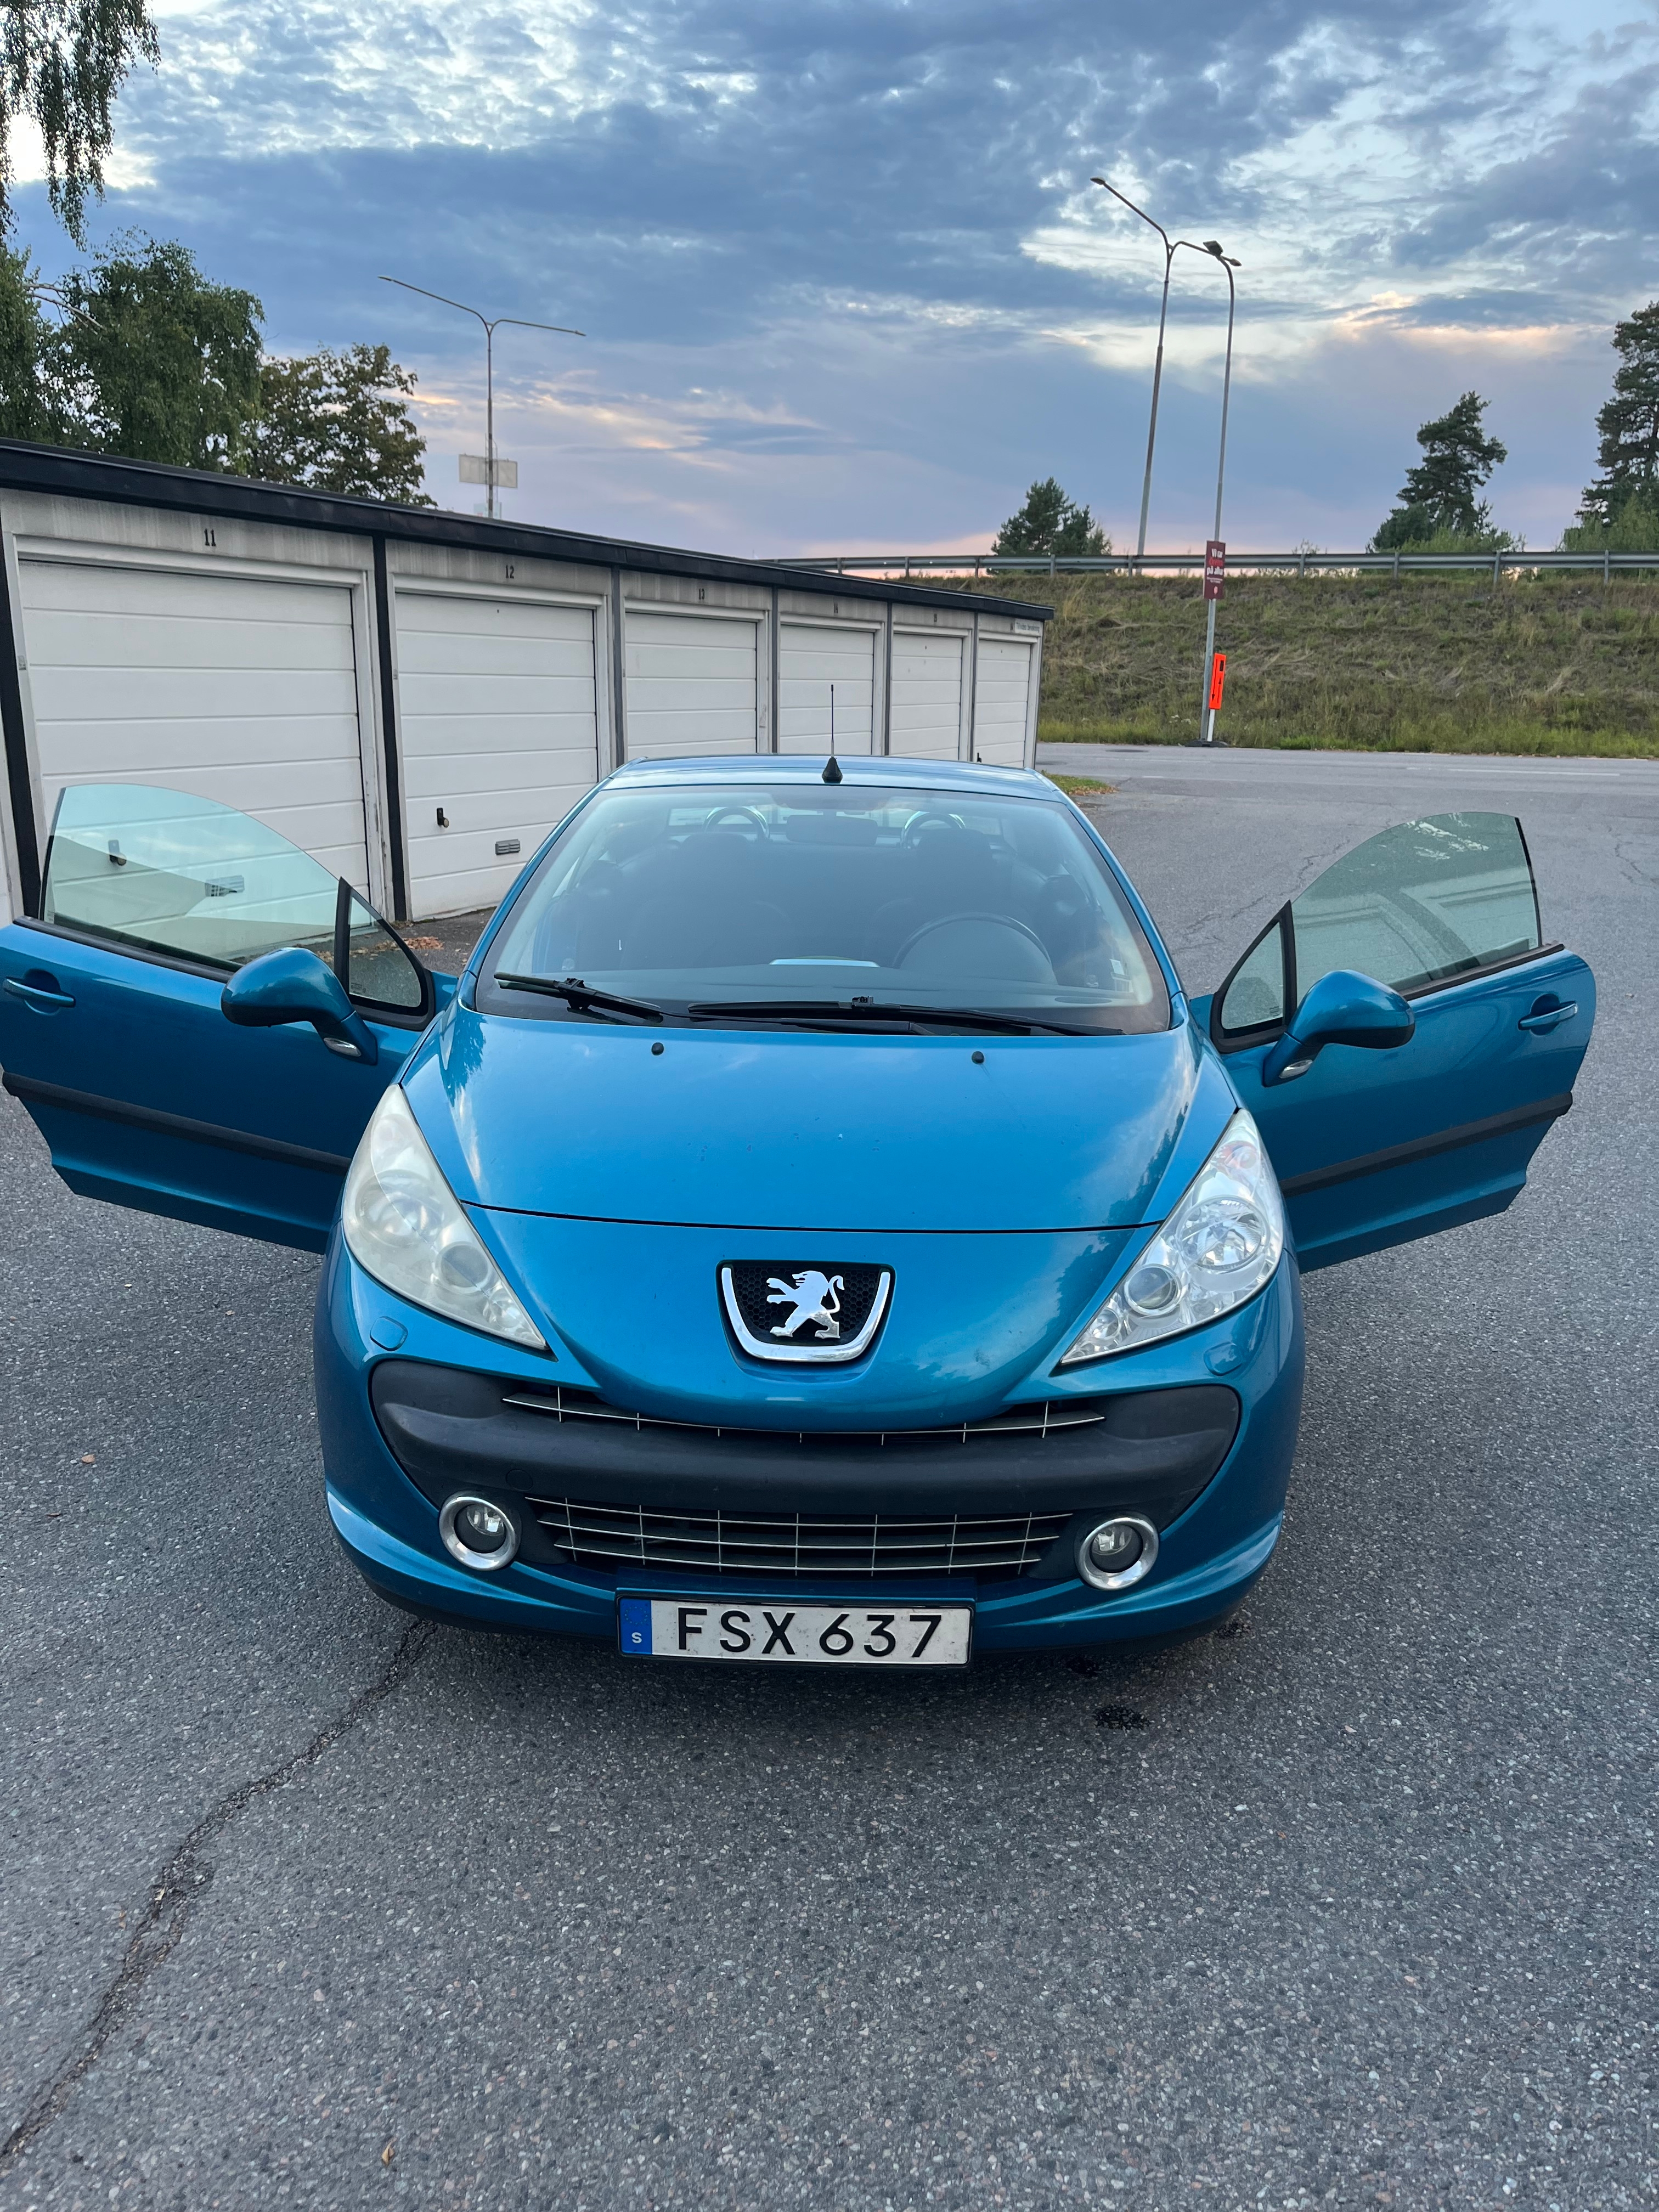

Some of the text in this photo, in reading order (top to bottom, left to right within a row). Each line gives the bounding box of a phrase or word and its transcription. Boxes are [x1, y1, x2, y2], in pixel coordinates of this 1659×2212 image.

[204, 528, 217, 547] 11
[505, 565, 515, 579] 12
[698, 588, 705, 600] 13
[631, 1632, 642, 1644] S
[678, 1606, 942, 1658] FSX 637
